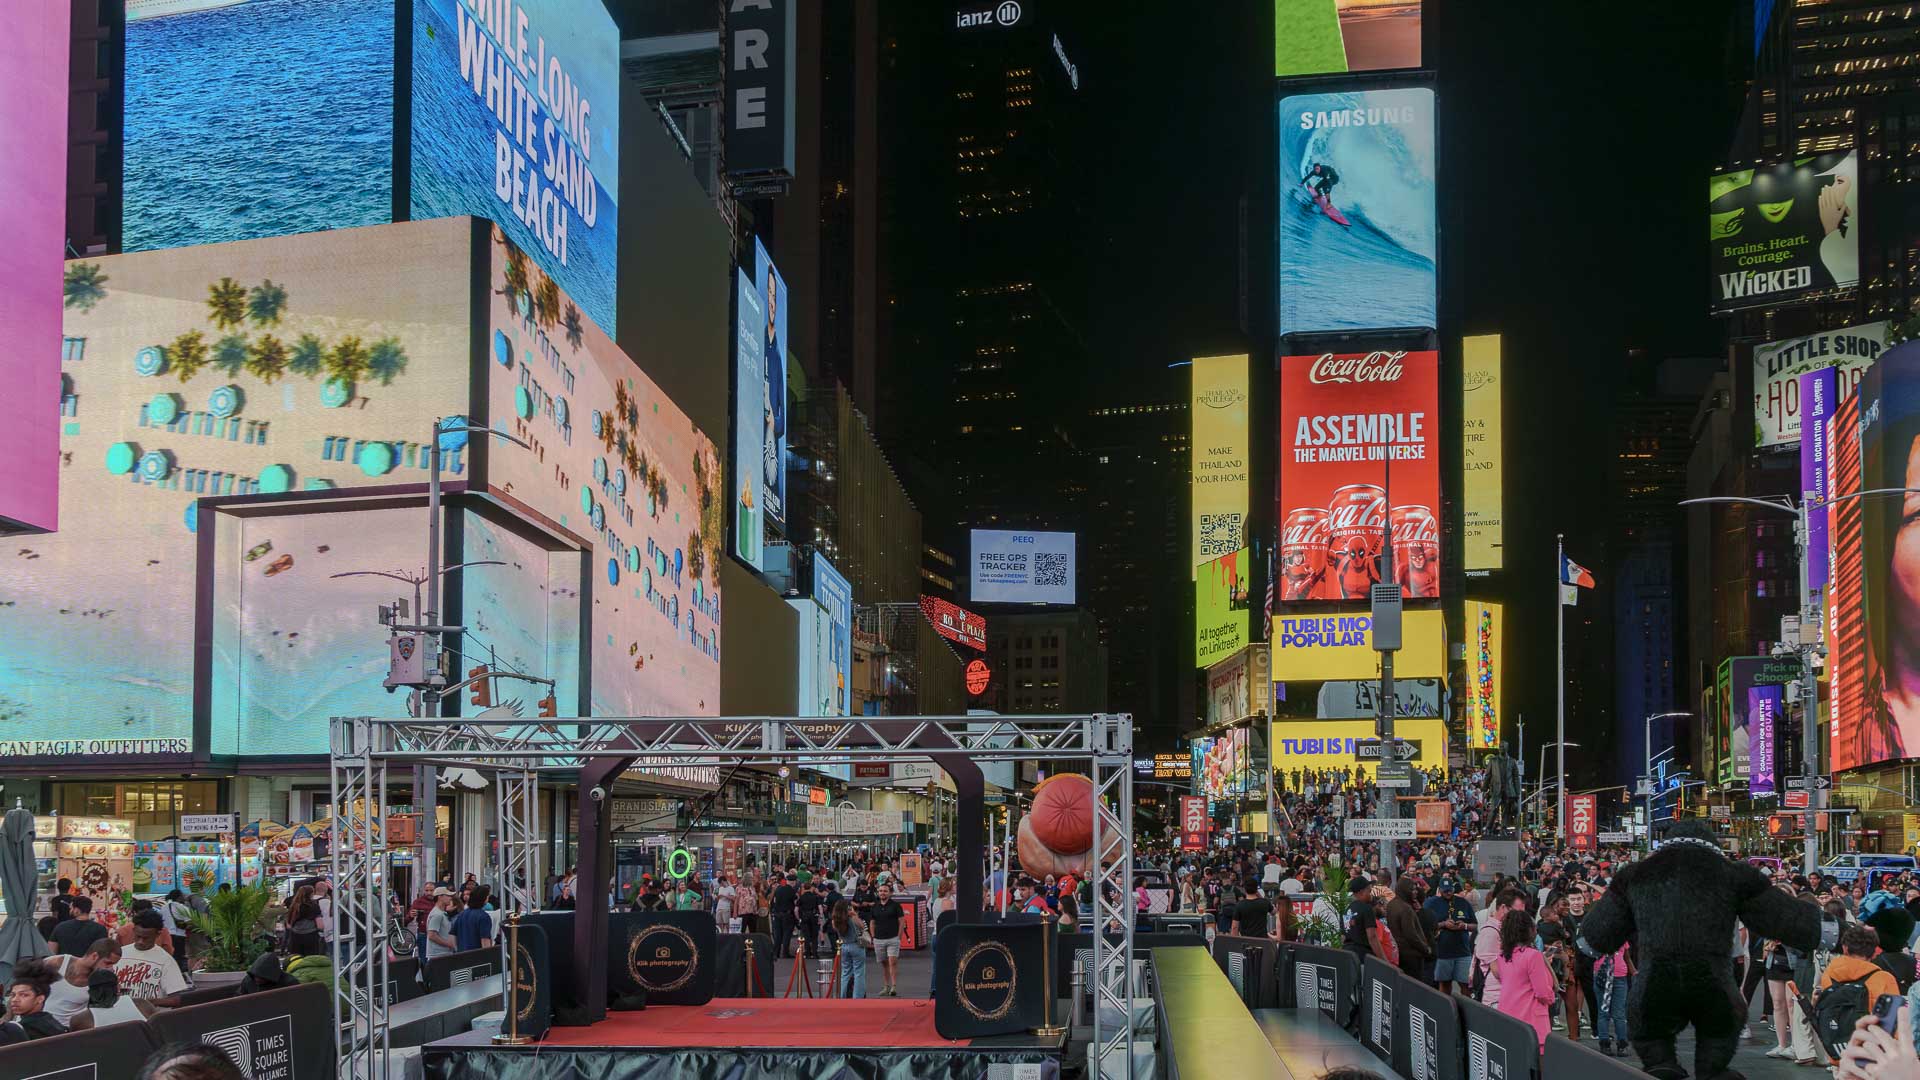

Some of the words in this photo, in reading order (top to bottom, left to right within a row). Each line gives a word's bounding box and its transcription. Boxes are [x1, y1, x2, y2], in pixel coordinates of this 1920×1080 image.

[456, 4, 538, 164] WHITE
[544, 118, 597, 228] SAND
[1300, 105, 1415, 130] SAMSUNG
[496, 128, 568, 267] BEACH
[1723, 242, 1767, 257] Brains.
[1769, 235, 1809, 250] Heart.
[1738, 250, 1794, 266] Courage.
[1768, 336, 1829, 379] LITTLE
[1834, 335, 1881, 359] SHOP
[1309, 350, 1409, 384] Coca-Cola
[1813, 360, 1826, 370] OF
[1295, 413, 1425, 446] ASSEMBLE
[1478, 419, 1485, 428] &
[1208, 447, 1233, 455] MAKE
[1294, 448, 1317, 463] THE
[1319, 446, 1366, 462] MARVEL
[1465, 447, 1475, 457] IN
[1199, 460, 1242, 469] THAILAND
[1195, 475, 1219, 484] YOUR
[1220, 473, 1247, 483] HOME
[1012, 535, 1035, 544] PEEQ
[1332, 529, 1368, 537] ORIGINAL
[980, 553, 1005, 561] FREE
[1007, 554, 1028, 562] GPS
[980, 562, 1026, 571] TRACKER
[967, 623, 985, 640] PLAZA
[1199, 629, 1208, 641] All
[1209, 622, 1237, 641] together
[1281, 619, 1320, 633] TUBI
[1322, 618, 1336, 632] IS
[1338, 617, 1373, 631] MO
[1281, 632, 1365, 648] POPULAR
[1200, 646, 1207, 657] on
[1209, 638, 1235, 654] Linktree
[1763, 663, 1787, 672] Pick
[1754, 673, 1796, 682] Choose
[35, 741, 84, 755] EAGLE
[89, 738, 188, 754] OUTFITTERS
[1282, 738, 1325, 755] TUBI
[1327, 738, 1341, 754] IS
[1364, 747, 1382, 756] ONE
[612, 800, 647, 811] GRAND
[648, 800, 675, 811] SLAM
[1187, 797, 1203, 832] tkts
[1572, 797, 1592, 834] tkts
[1353, 821, 1385, 829] PEDESTRIAN
[1386, 821, 1399, 829] FLOW
[1400, 821, 1414, 829] ZONE
[1353, 829, 1366, 837] KEEP
[1368, 829, 1387, 837] MOVING
[650, 960, 689, 968] photography
[977, 982, 1009, 990] photography
[1320, 978, 1333, 989] TIMES
[1319, 989, 1334, 1001] SQUARE
[255, 1034, 285, 1052] TIMES
[255, 1050, 288, 1070] SQUARE
